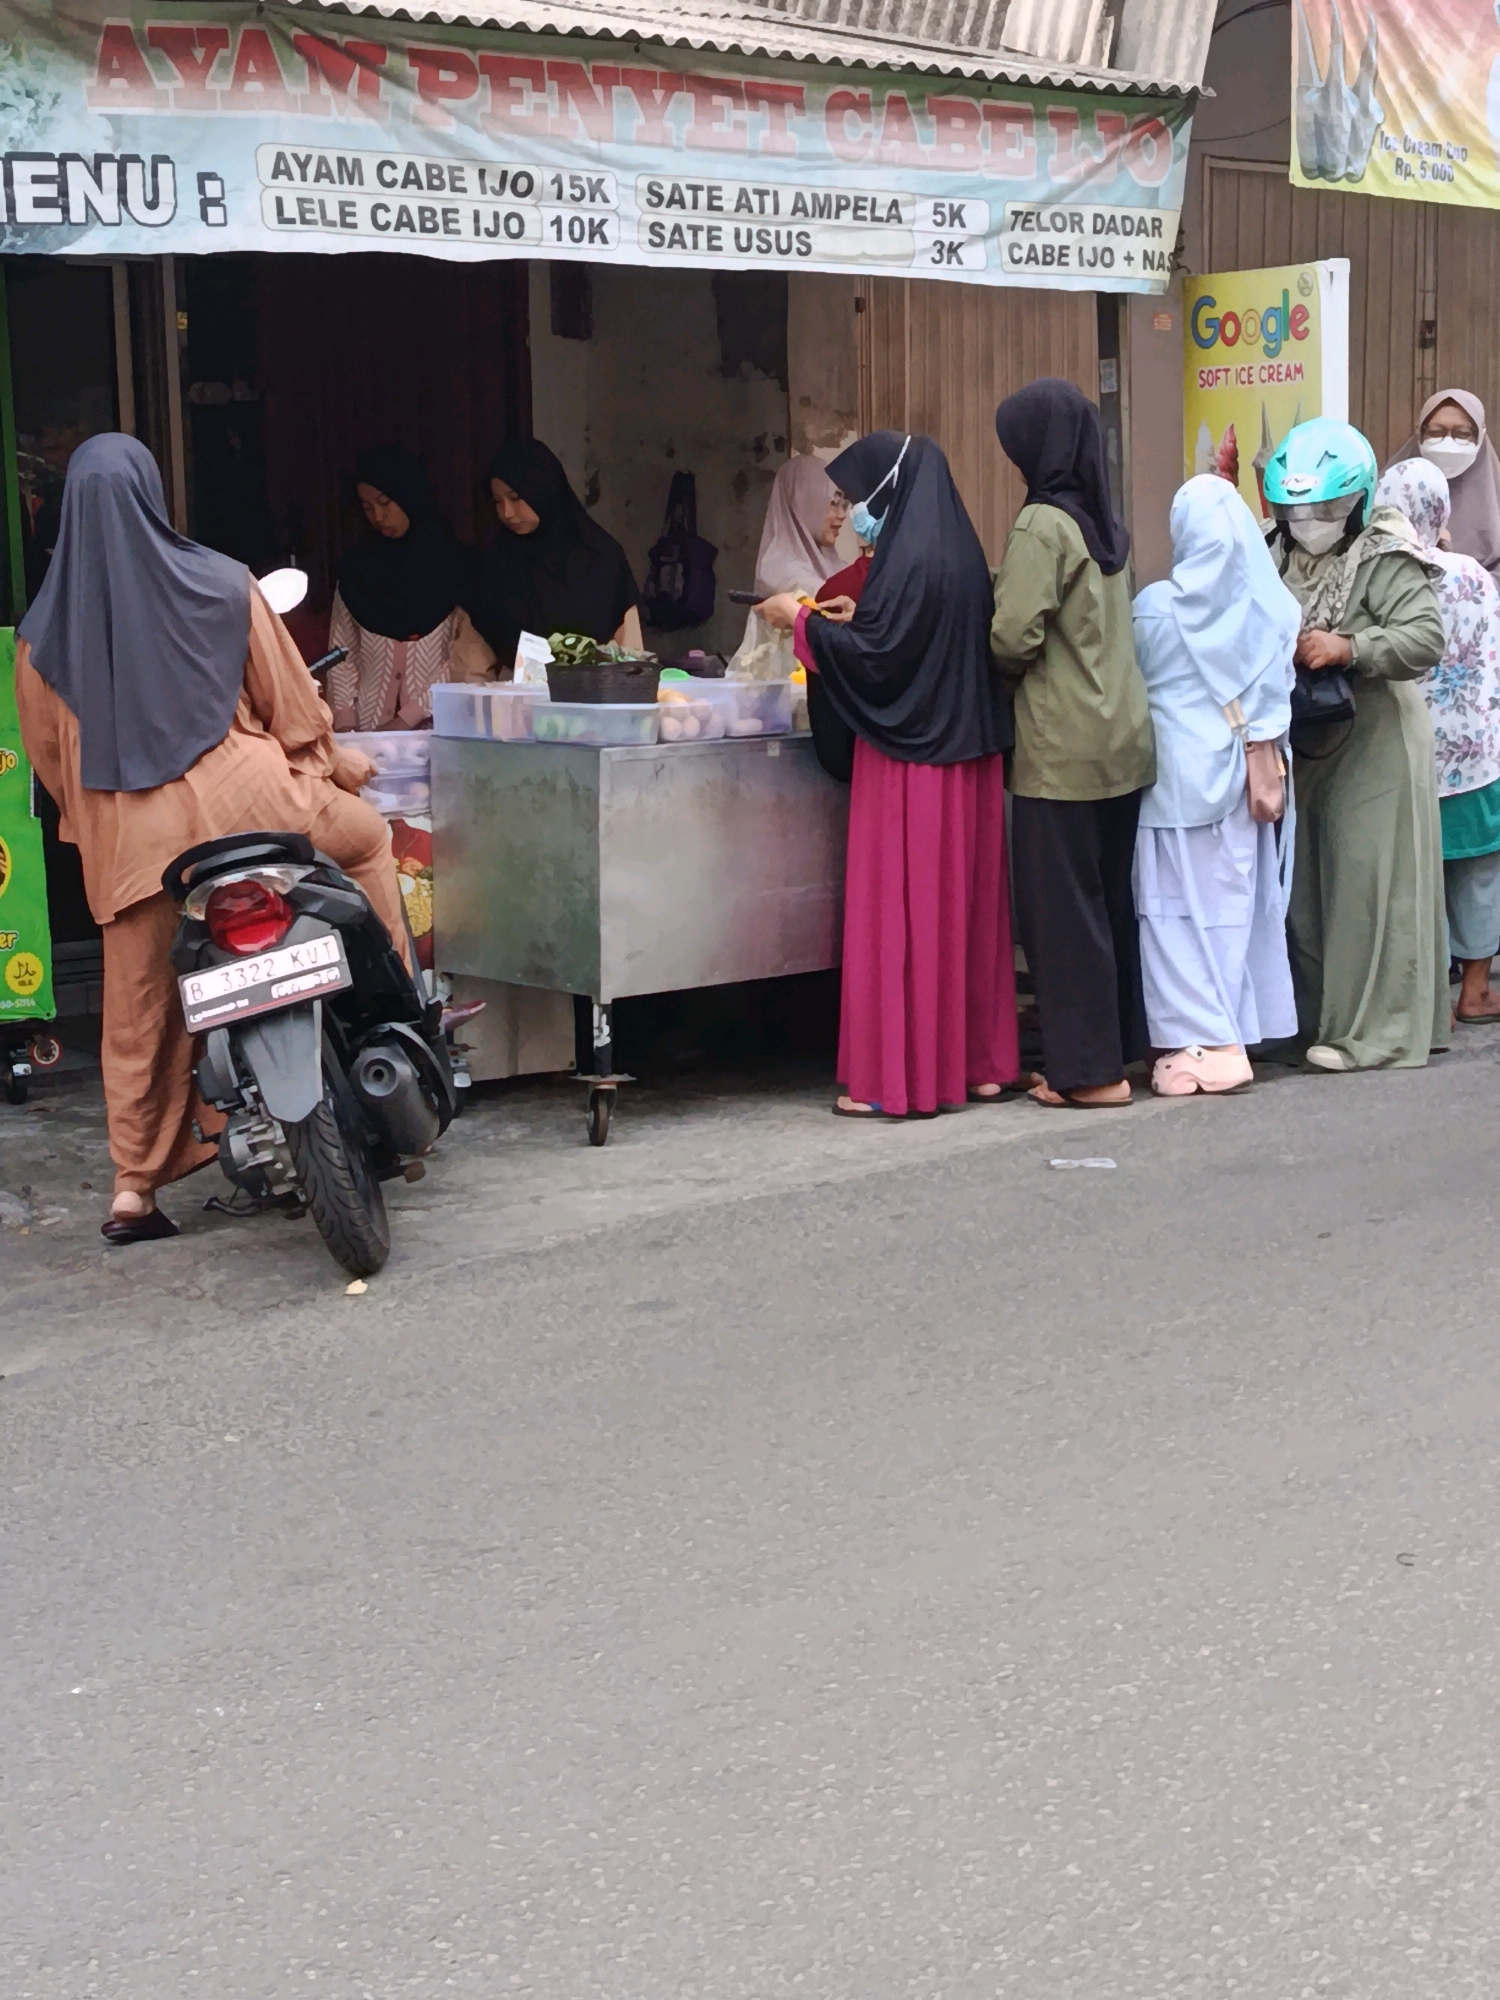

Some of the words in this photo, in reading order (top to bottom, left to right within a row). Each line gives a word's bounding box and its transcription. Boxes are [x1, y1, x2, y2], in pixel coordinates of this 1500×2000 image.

[85, 19, 390, 123] AYAM
[404, 45, 807, 158] PENYET
[824, 85, 1038, 180] CABE
[1047, 105, 1174, 186] IJO
[1380, 130, 1398, 151] Ice
[1403, 134, 1442, 157] Cream
[0, 151, 177, 227] ENU
[271, 151, 364, 186] AYAM
[376, 159, 468, 194] CABE
[478, 168, 535, 199] IJO
[550, 173, 611, 204] 15K
[1395, 157, 1415, 181] Rp.
[275, 196, 358, 230] LELE
[370, 203, 462, 236] CABE
[473, 209, 526, 240] IJO
[550, 215, 610, 245] 10K
[646, 181, 724, 212] SATE
[734, 187, 780, 216] ATI
[790, 191, 903, 224] AMPELA
[932, 202, 967, 229] 5K
[1009, 210, 1085, 235] TELOR
[1092, 213, 1163, 239] DADAR
[647, 221, 723, 252] SATE
[734, 227, 813, 257] USUS
[930, 240, 965, 266] 3K
[1008, 242, 1070, 267] CABE
[1078, 246, 1115, 269] IJO
[1191, 288, 1310, 358] Google
[1198, 368, 1231, 388] SOFT
[1235, 365, 1254, 385] ICE
[1259, 363, 1304, 384] CREAM
[190, 981, 204, 1001] B
[220, 958, 276, 992] 3322
